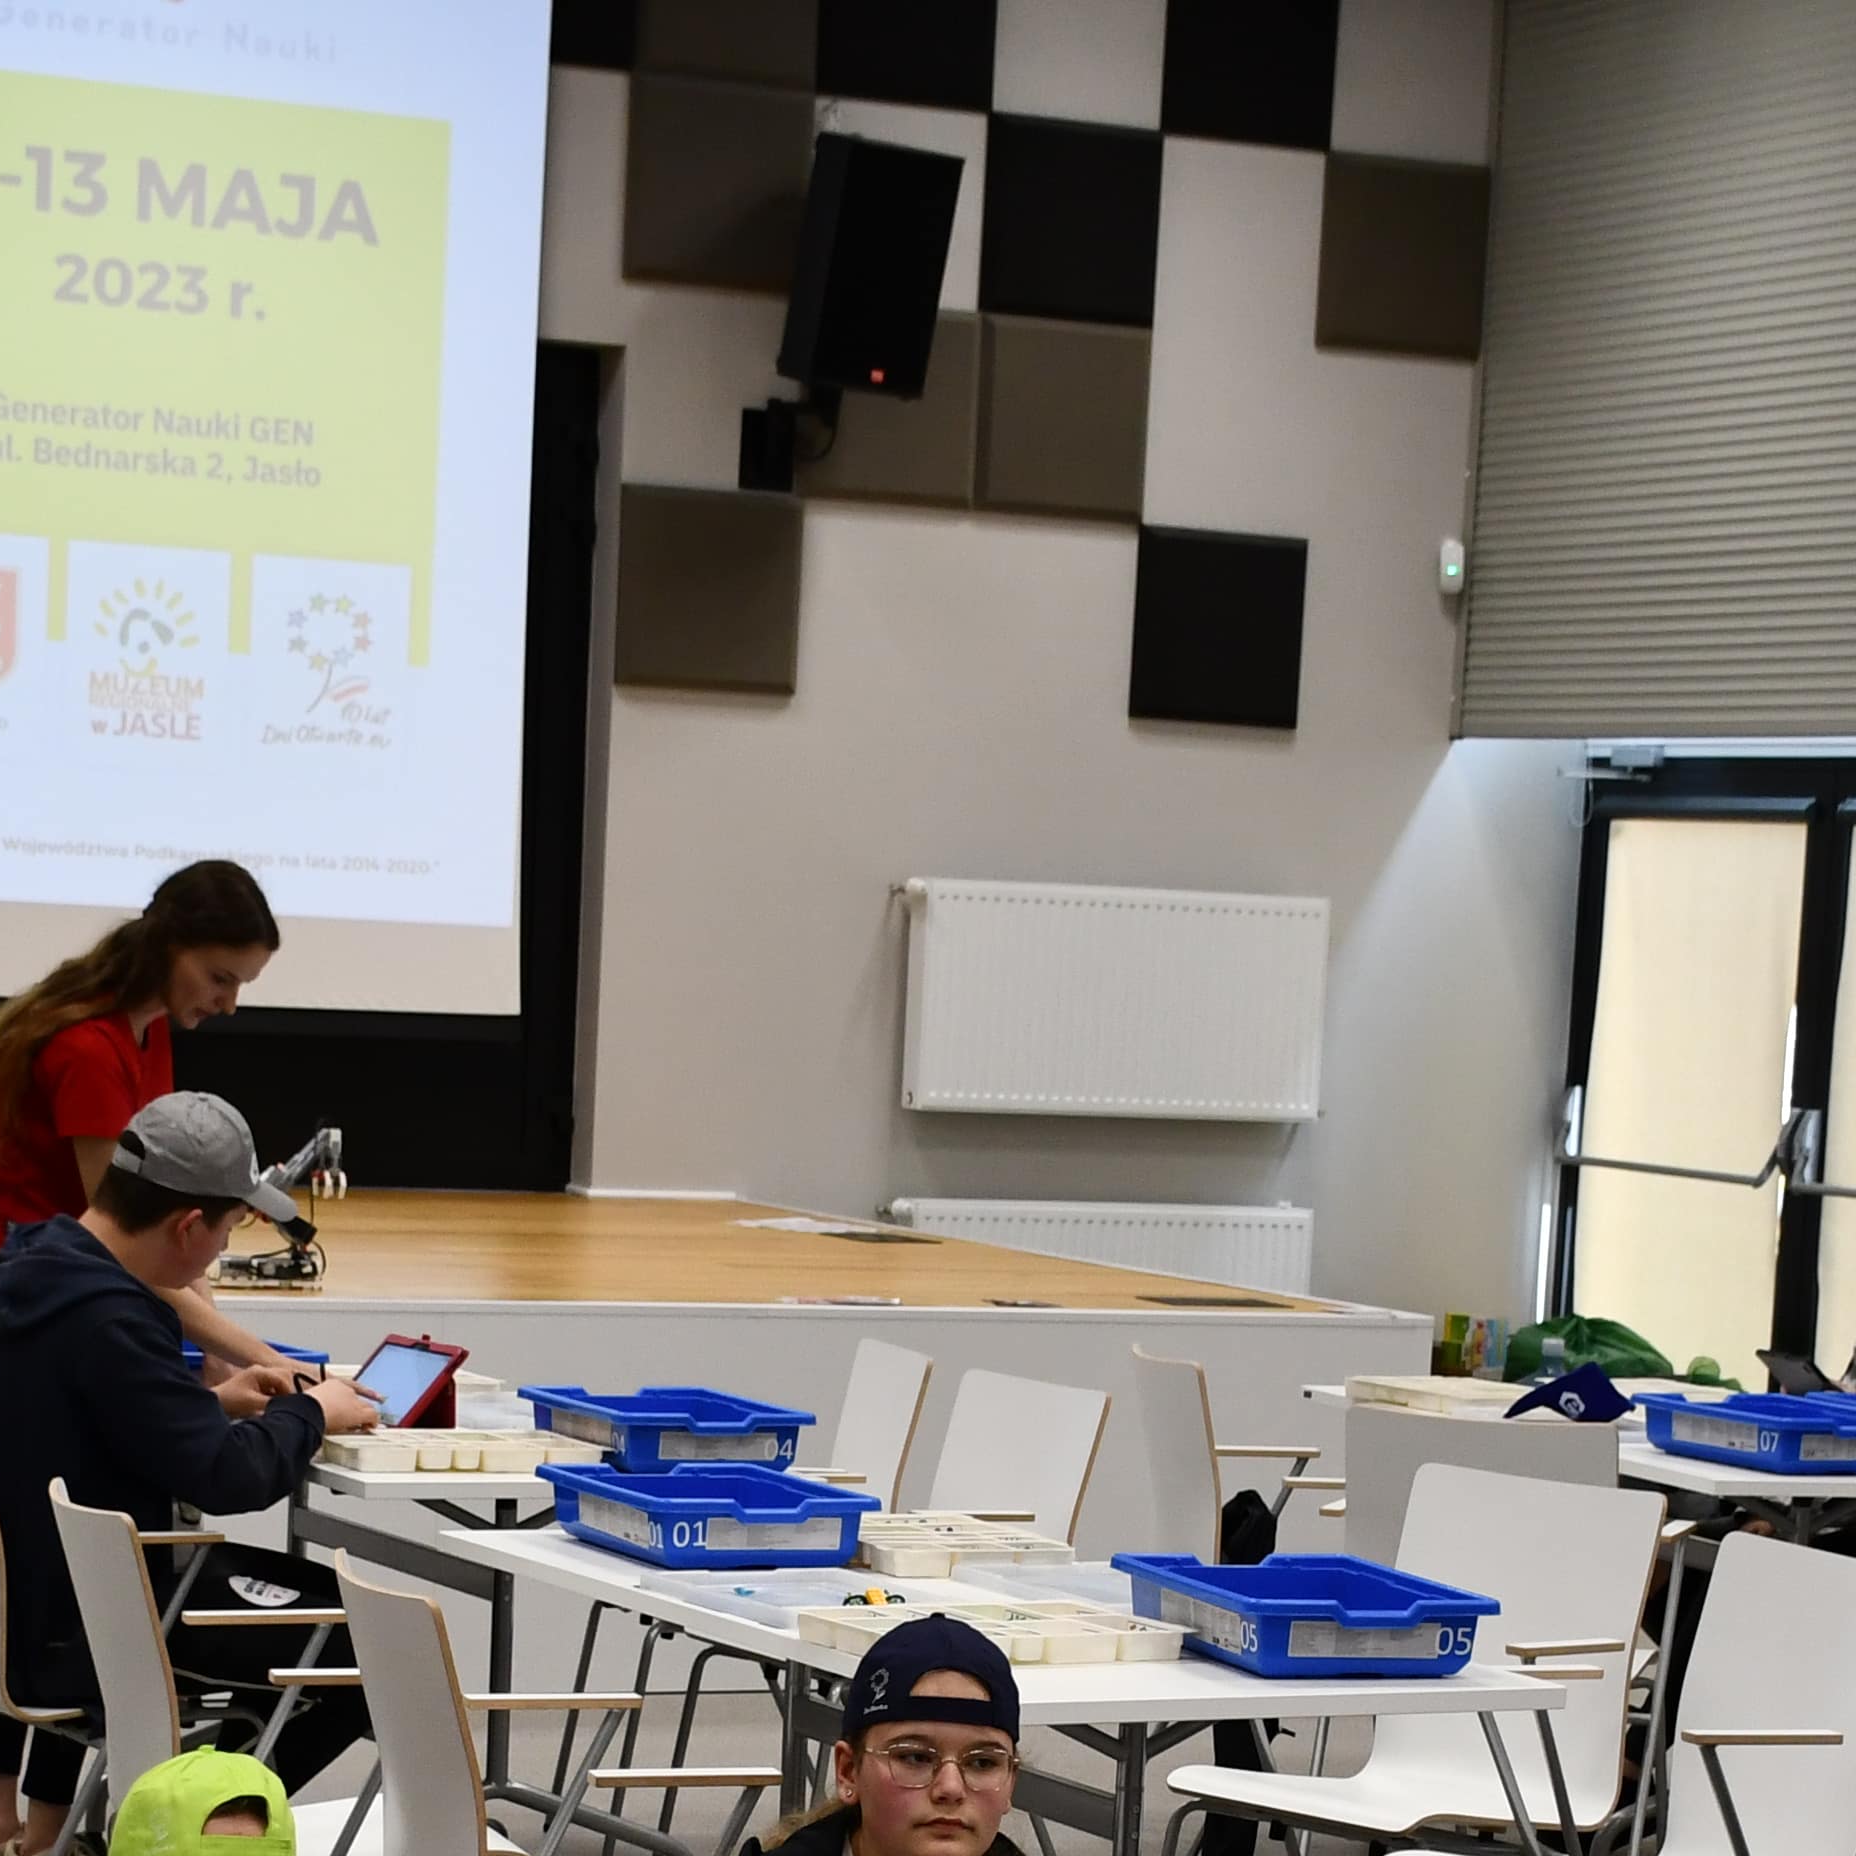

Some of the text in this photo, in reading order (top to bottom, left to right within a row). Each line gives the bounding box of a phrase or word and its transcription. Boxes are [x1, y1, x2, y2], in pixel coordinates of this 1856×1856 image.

[223, 24, 338, 64] Nauki
[135, 156, 380, 247] MAJA
[53, 253, 266, 321] 2023 r.
[152, 406, 241, 442] Nauki
[249, 415, 314, 446] GEN
[33, 438, 196, 480] Bednarska
[207, 453, 234, 485] 2,
[242, 459, 320, 489] Jasło
[89, 670, 204, 699] MUZEUM
[763, 1437, 793, 1461] 04
[1759, 1431, 1781, 1454] 07
[648, 1519, 664, 1550] 01
[671, 1519, 706, 1549] 01
[1239, 1620, 1259, 1654] 05
[1435, 1626, 1473, 1657] 05
